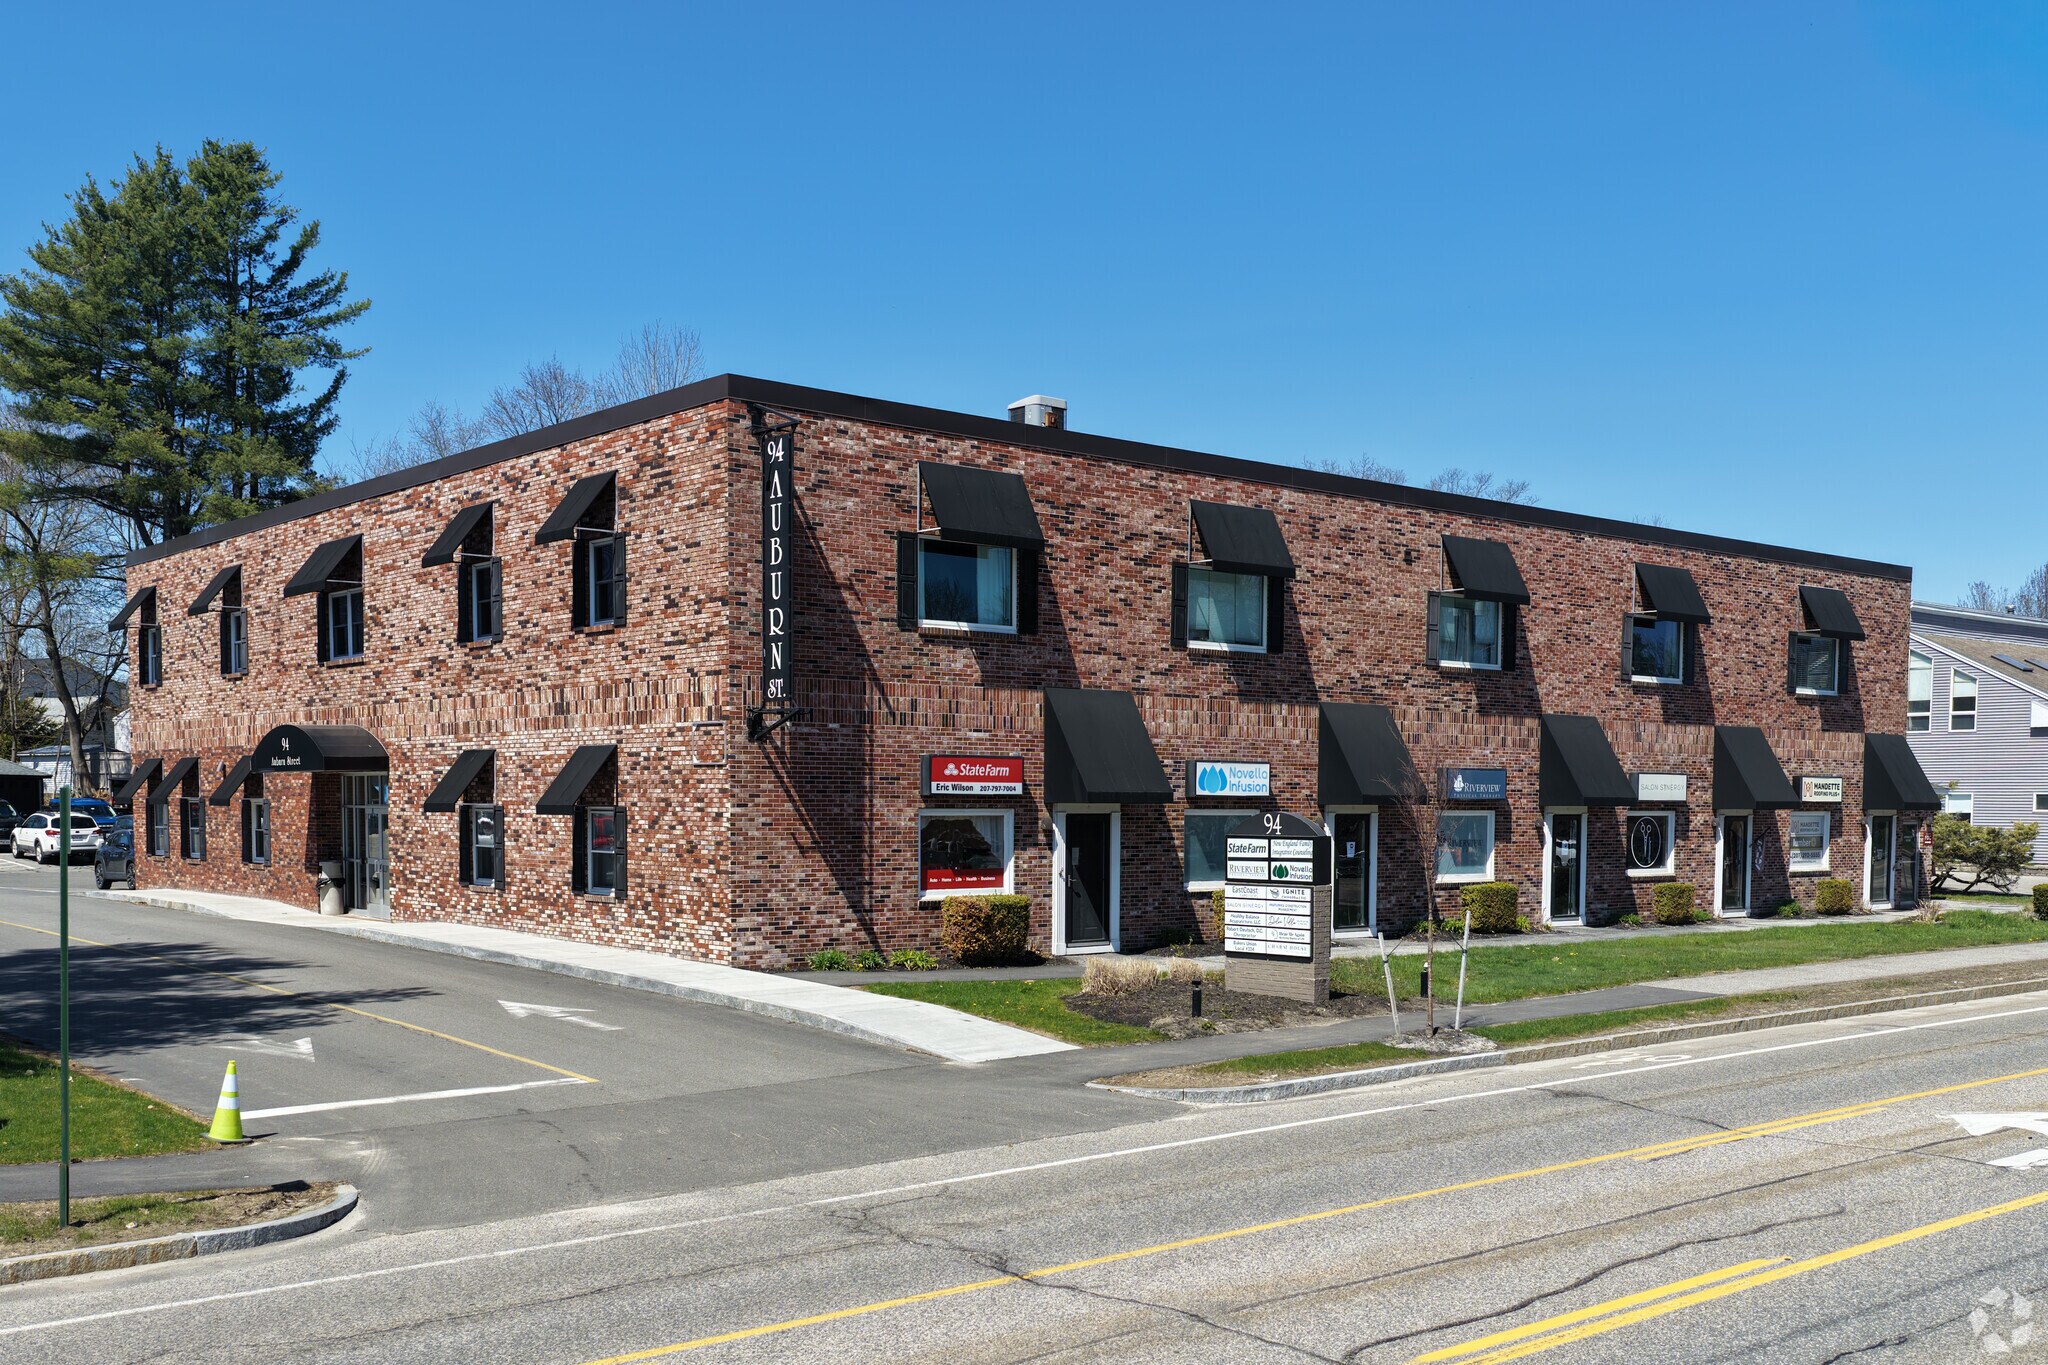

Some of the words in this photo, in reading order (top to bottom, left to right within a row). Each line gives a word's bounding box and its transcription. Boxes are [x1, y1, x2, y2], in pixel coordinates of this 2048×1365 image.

[767, 437, 784, 463] 94
[769, 469, 784, 670] AUBURN
[767, 678, 786, 698] ST.
[281, 737, 289, 751] 94
[936, 783, 949, 791] Eric
[951, 784, 974, 792] Wilson
[1229, 780, 1268, 792] Infusion
[1464, 782, 1501, 792] RIVERVIEW
[1640, 783, 1658, 791] SALON
[1813, 783, 1840, 791] MANDETTE
[1263, 813, 1282, 835] 94
[1229, 863, 1266, 873] RIVERVIEW
[1289, 872, 1313, 880] Infusion
[1282, 888, 1305, 896] IGNITE
